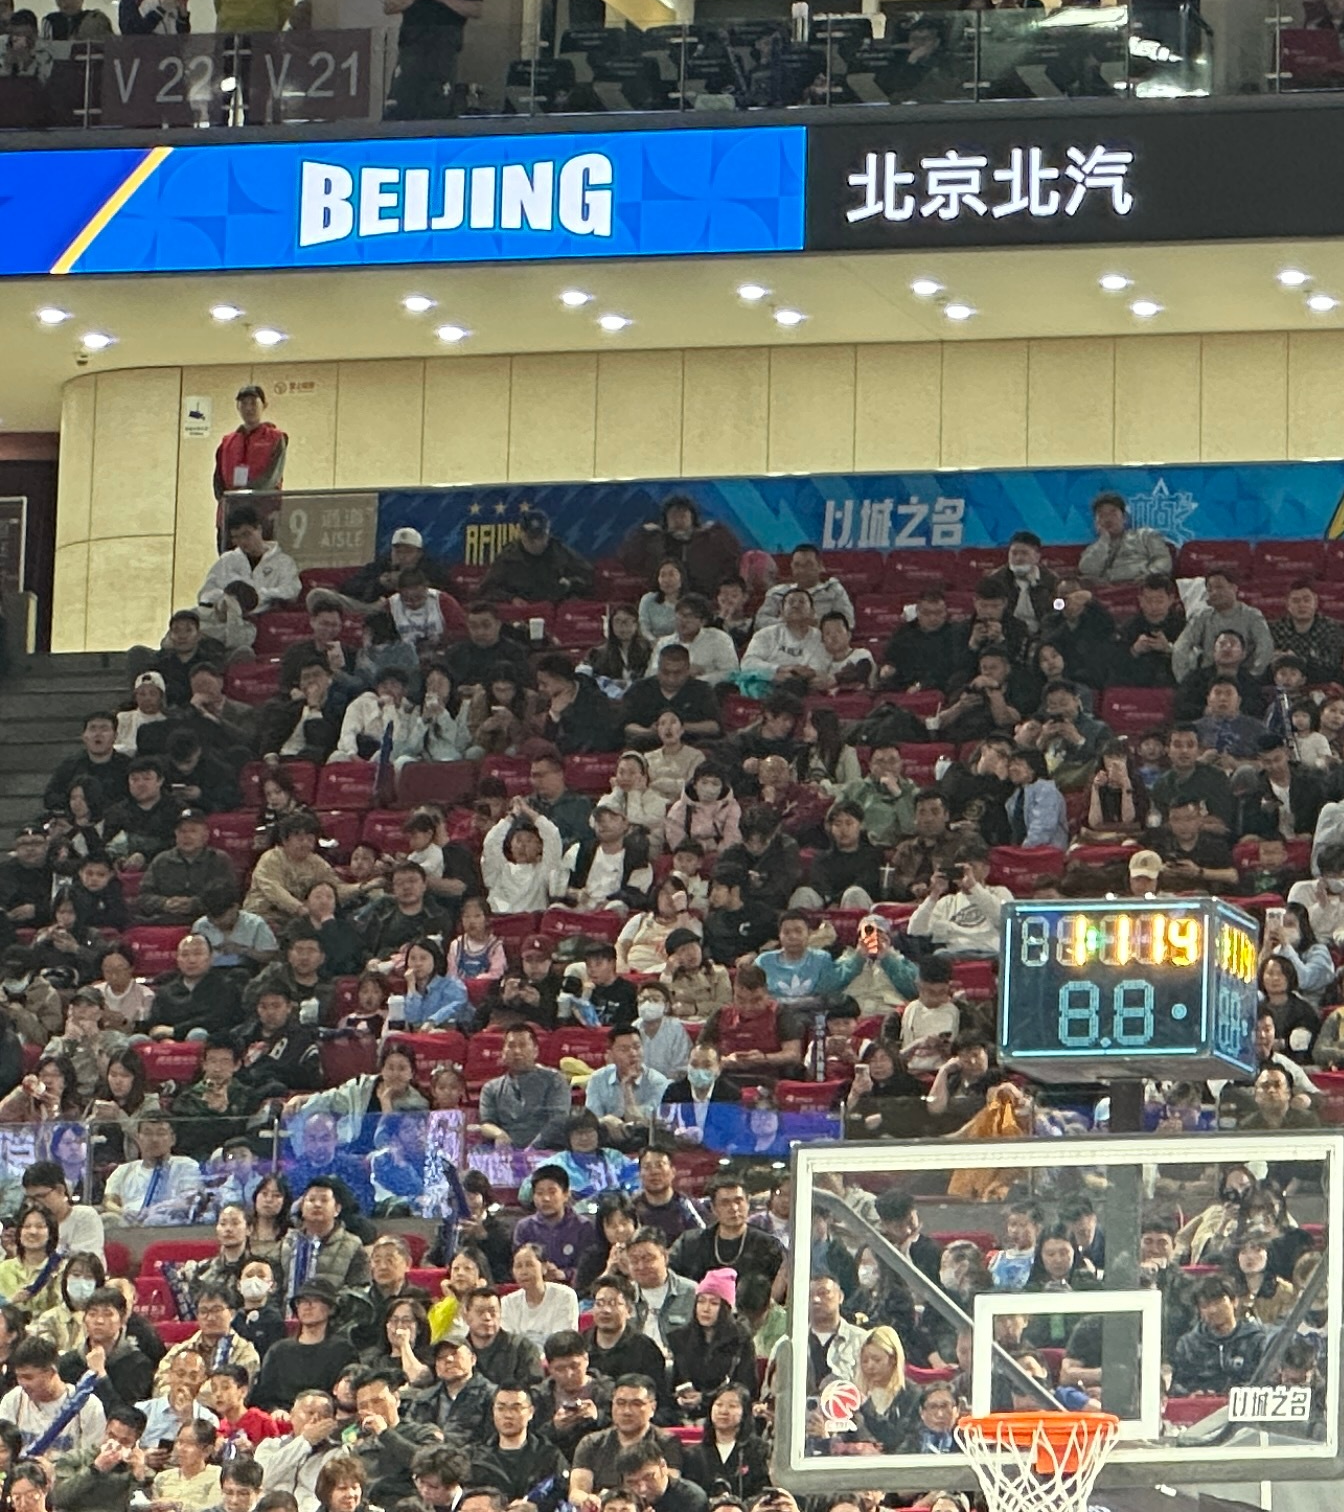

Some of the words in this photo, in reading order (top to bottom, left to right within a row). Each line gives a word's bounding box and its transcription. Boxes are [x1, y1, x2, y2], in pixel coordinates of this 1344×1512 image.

[113, 59, 138, 103] V
[156, 55, 213, 103] 22
[265, 52, 290, 98] V
[309, 51, 359, 98] 21
[300, 153, 613, 248] BEIJING
[847, 145, 1135, 224] 北京北汽
[822, 495, 966, 549] 以城之名
[1232, 1391, 1307, 1417] 以城之名
